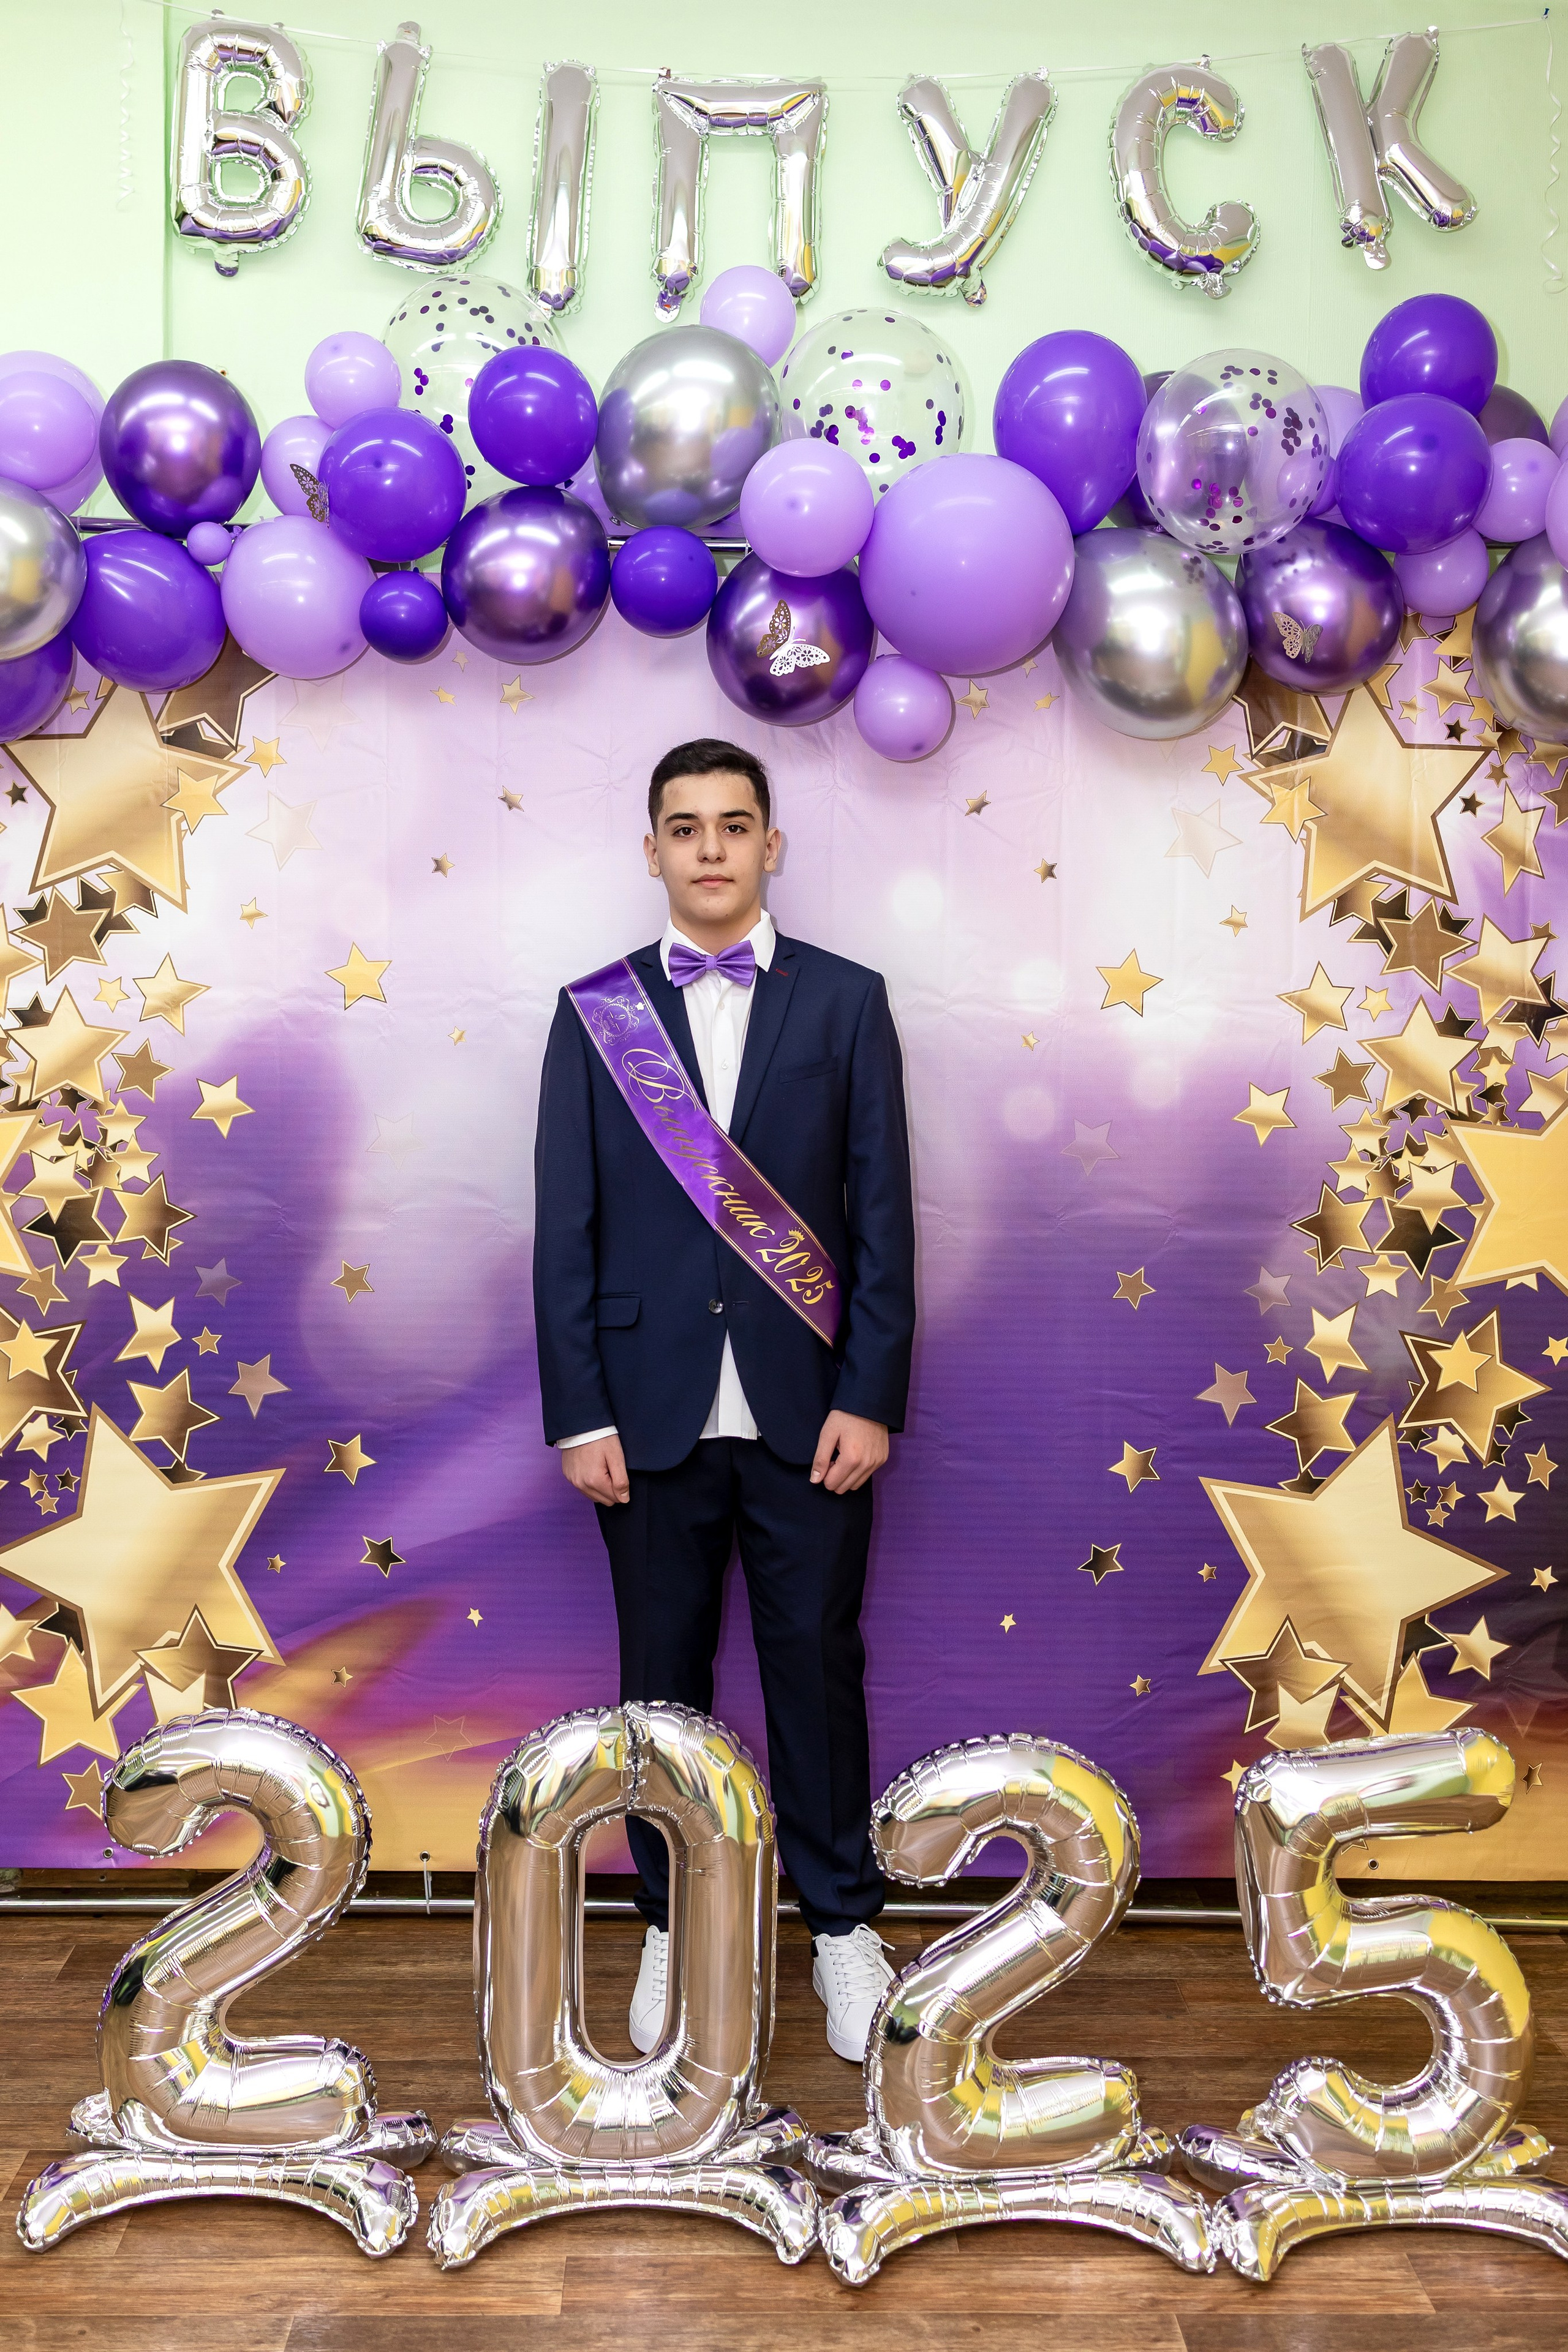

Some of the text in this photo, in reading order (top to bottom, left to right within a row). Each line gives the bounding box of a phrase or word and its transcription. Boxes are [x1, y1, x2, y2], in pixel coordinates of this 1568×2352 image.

[621, 1048, 835, 1305] Выпускник 2025
[96, 1701, 1535, 2180] 2025
